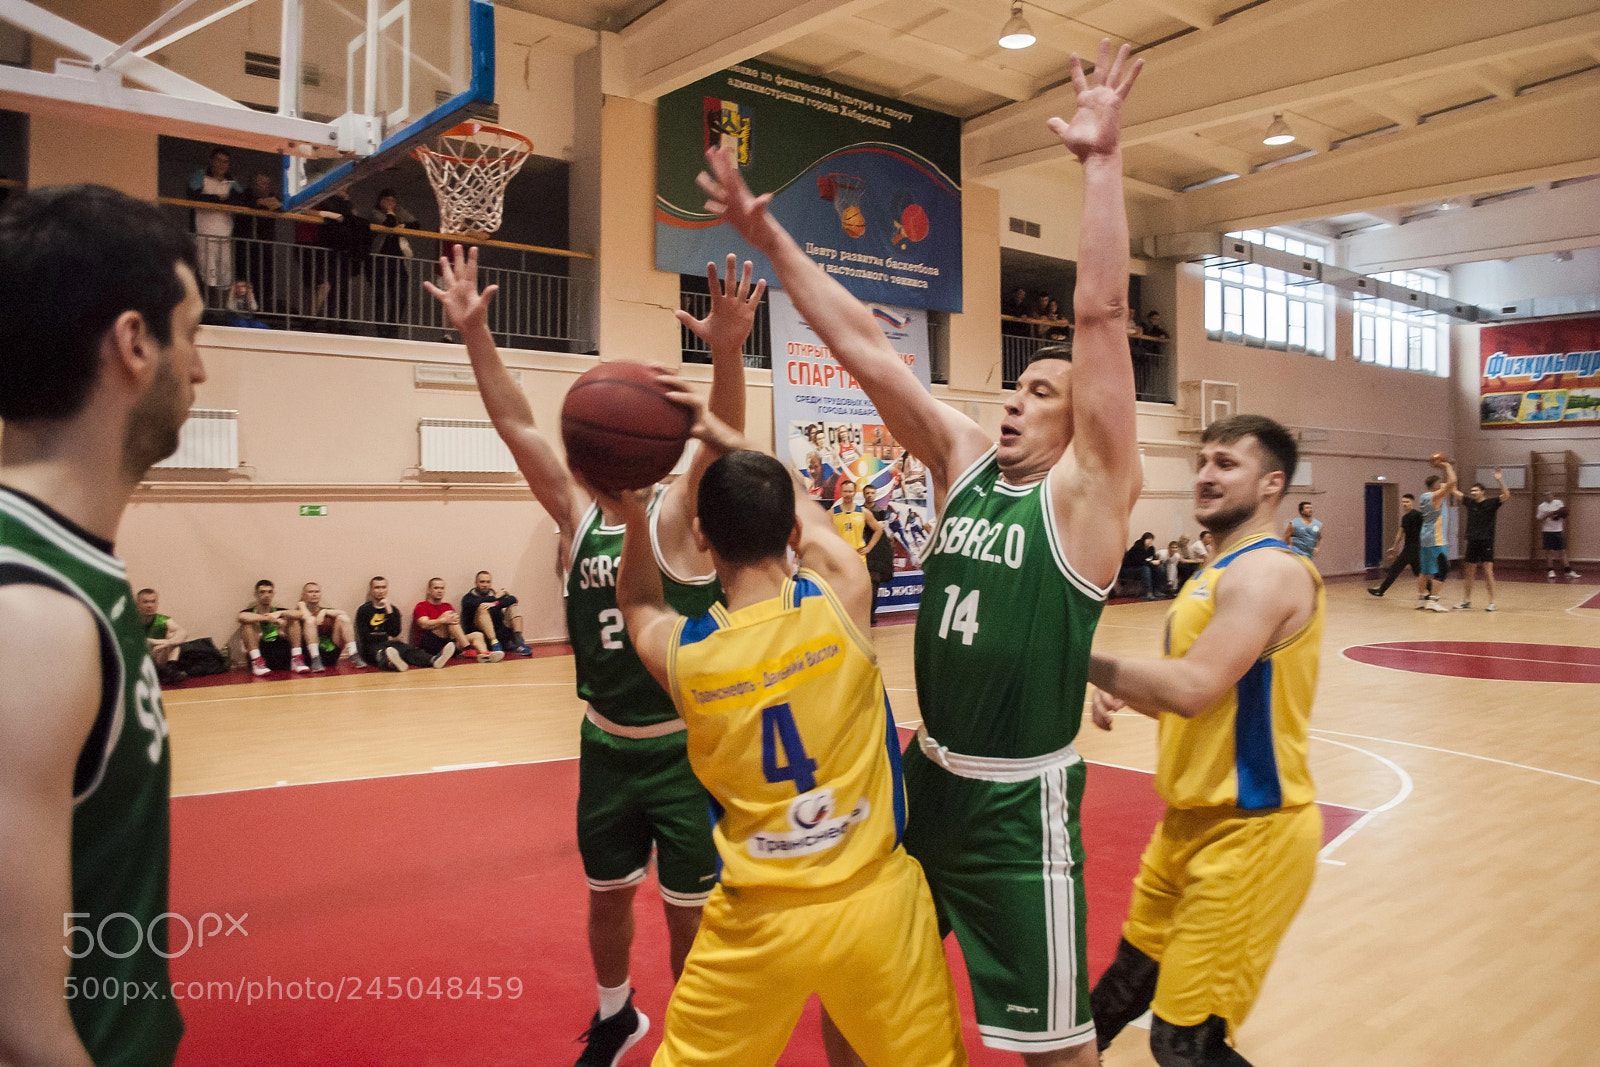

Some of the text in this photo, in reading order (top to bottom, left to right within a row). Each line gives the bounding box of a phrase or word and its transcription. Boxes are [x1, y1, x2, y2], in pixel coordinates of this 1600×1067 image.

[805, 242, 940, 276] Центр развития баскетбола
[826, 264, 889, 282] настольного
[890, 275, 928, 289] тенниса
[795, 395, 821, 404] СРЕДИ
[818, 406, 847, 415] ГОРОДА
[934, 516, 1025, 569] SBR2.0
[599, 608, 624, 649] 2
[938, 584, 980, 645] 14
[805, 643, 839, 667] Восток
[762, 702, 818, 794] 4
